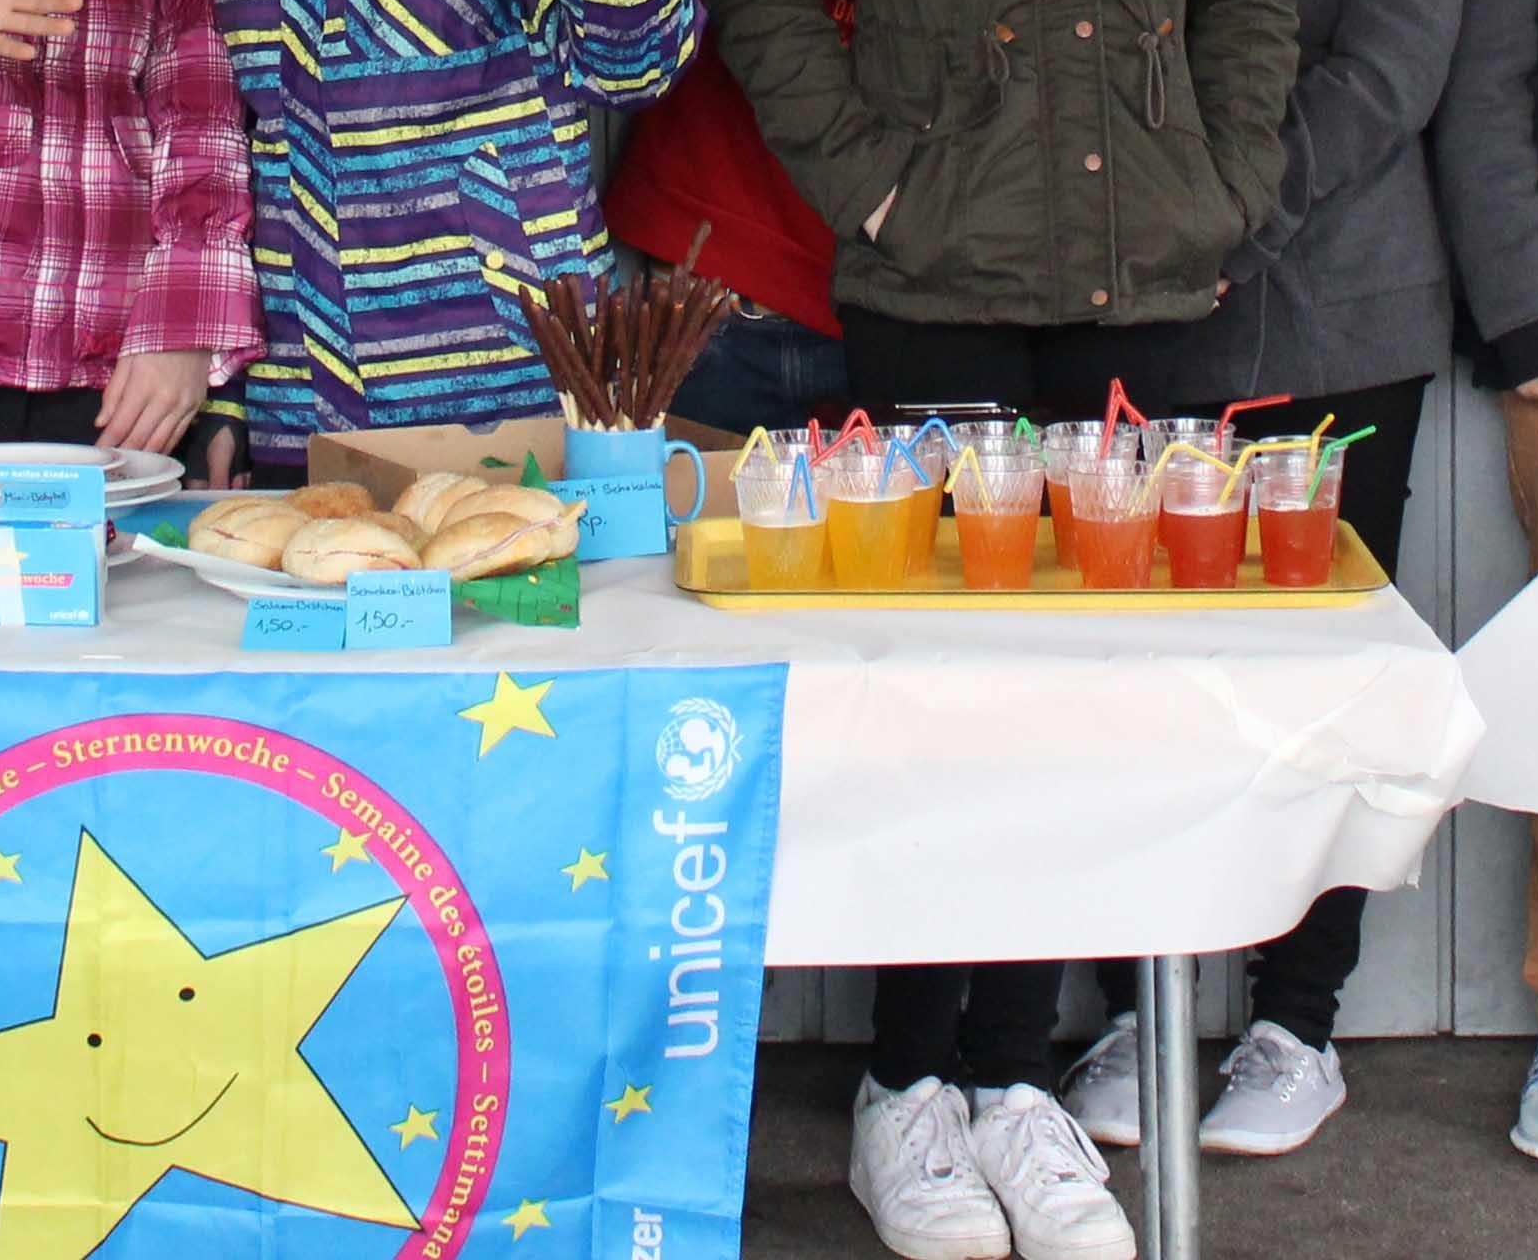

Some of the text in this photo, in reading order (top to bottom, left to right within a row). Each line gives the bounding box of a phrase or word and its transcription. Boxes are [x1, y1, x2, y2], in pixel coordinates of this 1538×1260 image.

[52, 731, 290, 773] Sternenwoche
[321, 771, 434, 882] Semaine
[429, 885, 466, 938] des
[649, 809, 728, 1058] unicef
[457, 944, 499, 1053] étoiles
[422, 1093, 499, 1260] Settimana
